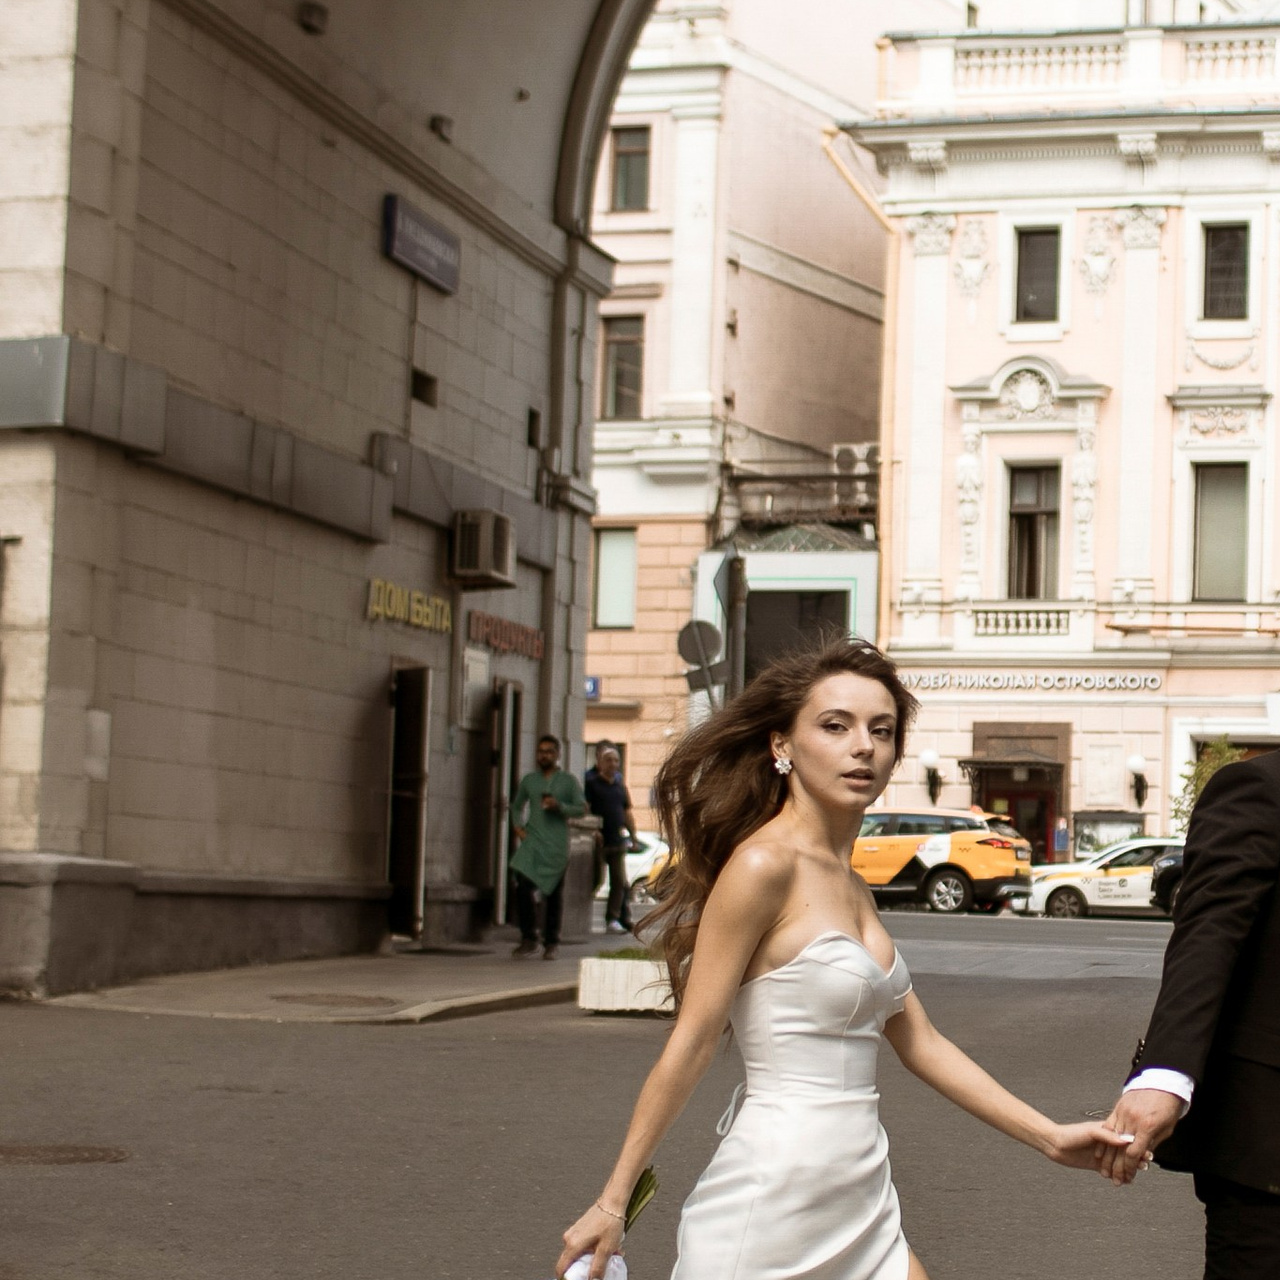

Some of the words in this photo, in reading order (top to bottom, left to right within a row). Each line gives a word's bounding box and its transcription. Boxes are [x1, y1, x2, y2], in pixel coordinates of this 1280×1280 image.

[370, 579, 409, 620] ДОМ
[409, 589, 451, 633] БЫТА
[470, 610, 545, 660] ПРОДУКТЫ
[898, 671, 951, 689] МУЗЕЙ
[954, 673, 1037, 689] НИКОЛАЯ
[1039, 673, 1162, 691] ОСТРОВСКОГО
